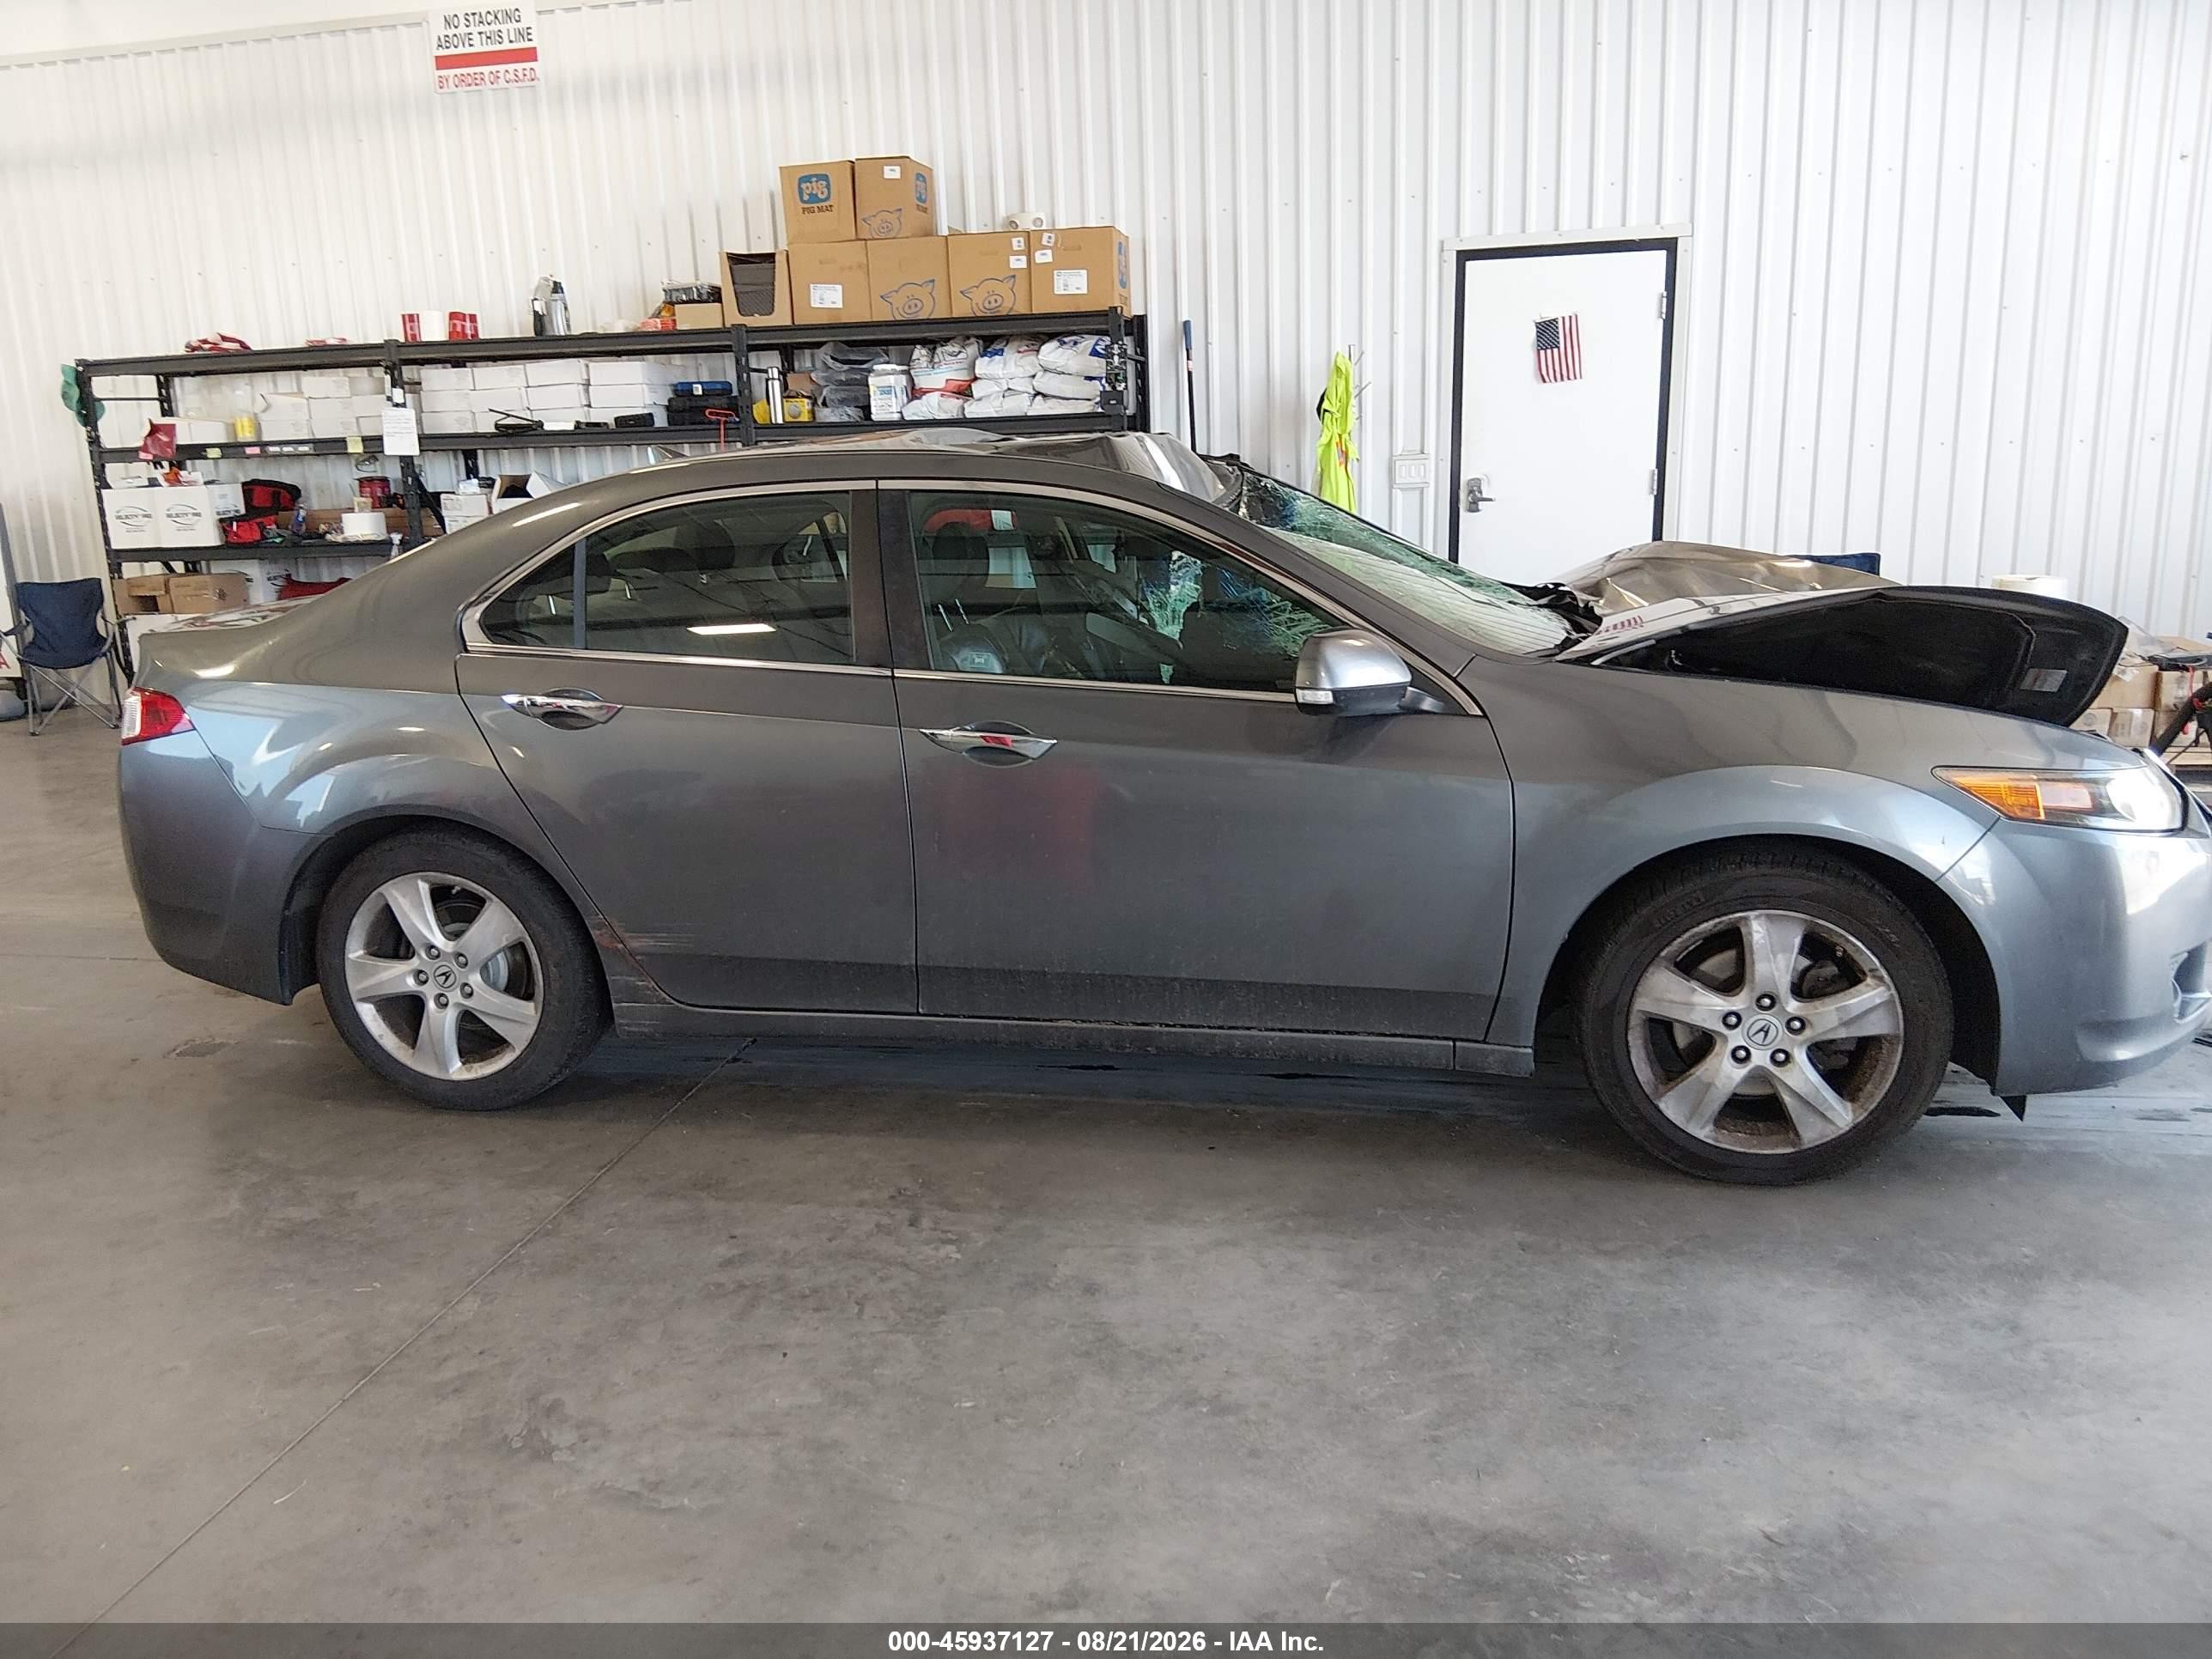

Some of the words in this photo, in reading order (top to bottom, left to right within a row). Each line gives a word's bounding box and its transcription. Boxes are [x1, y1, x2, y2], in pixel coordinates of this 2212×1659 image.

[444, 13, 460, 30] NO
[464, 8, 521, 28] STACKING
[436, 32, 474, 51] ABOVE
[477, 29, 504, 46] THIS
[507, 27, 533, 43] LINE
[438, 75, 450, 89] BY
[453, 71, 486, 88] ORDER
[489, 70, 501, 85] OF
[800, 177, 829, 201] pig
[801, 206, 816, 215] PIG
